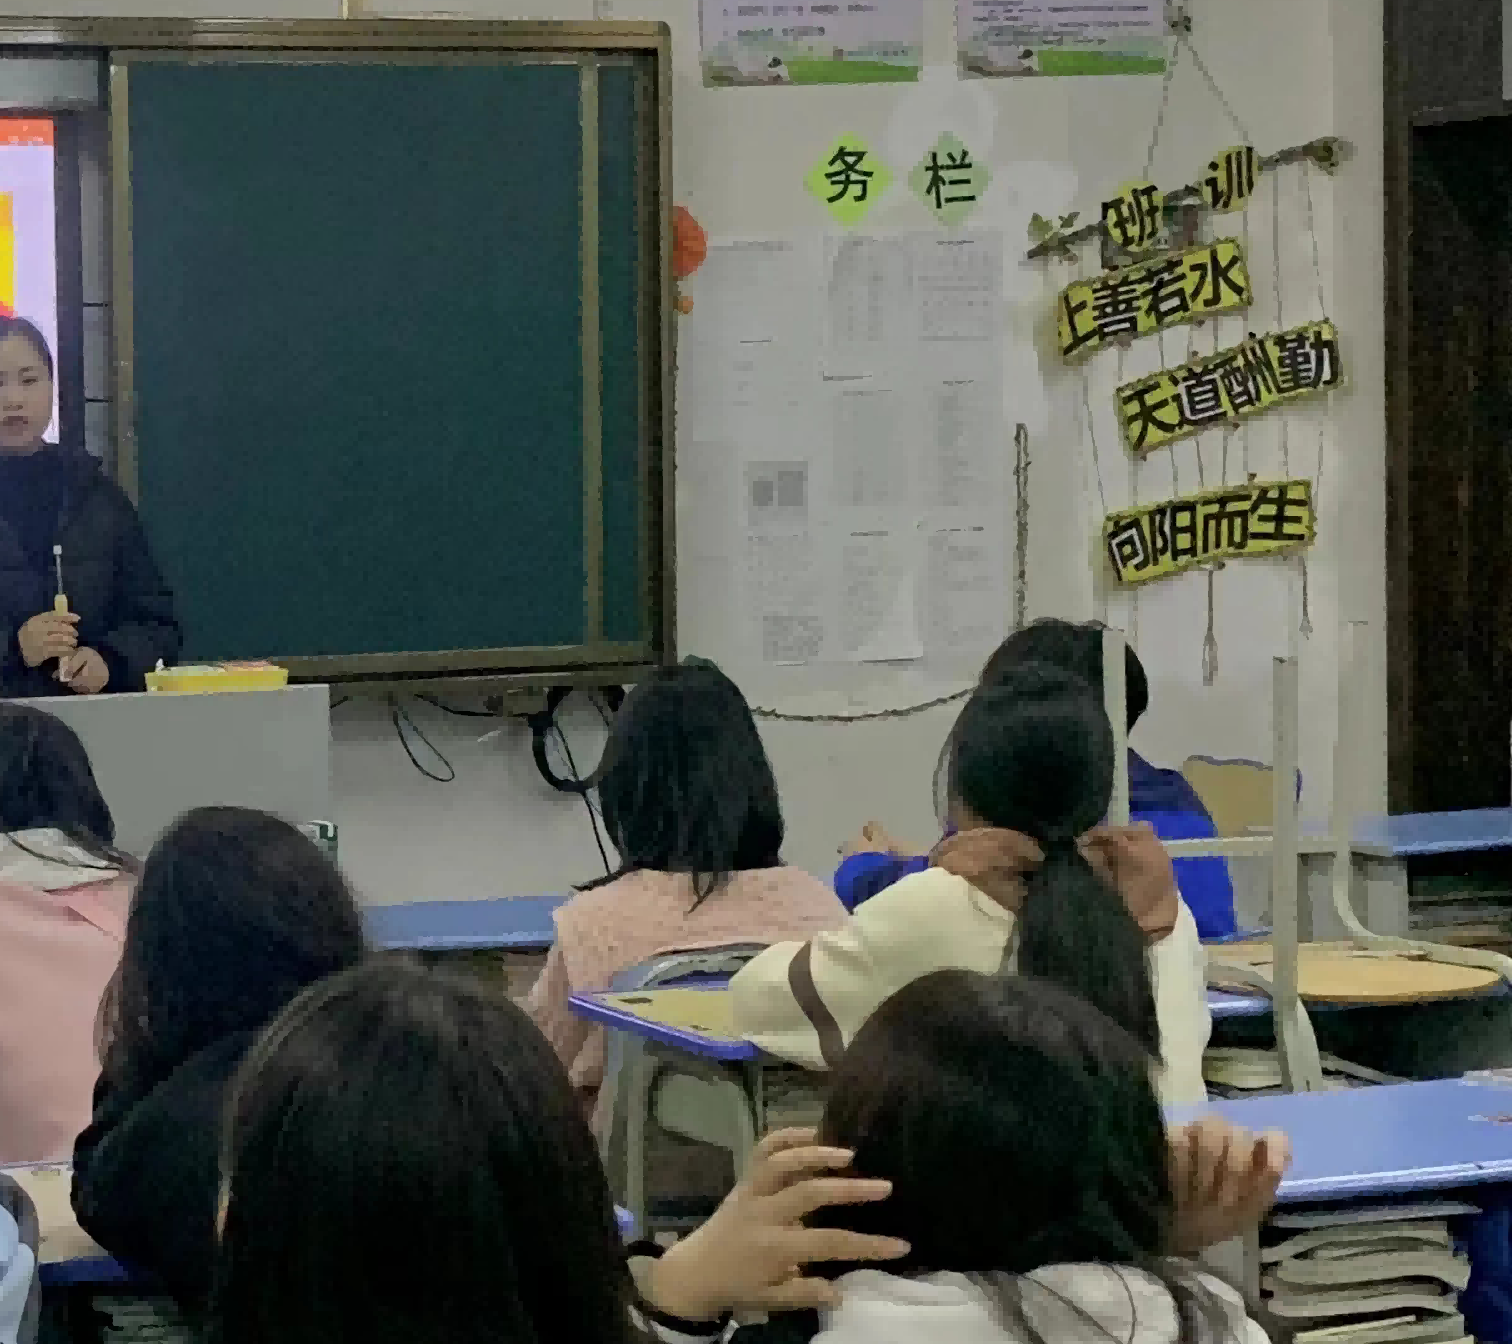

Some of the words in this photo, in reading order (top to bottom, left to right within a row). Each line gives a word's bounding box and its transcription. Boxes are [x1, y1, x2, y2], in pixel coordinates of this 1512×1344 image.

[824, 146, 874, 203] 务
[925, 148, 976, 209] 栏
[1105, 184, 1161, 249] 班
[1204, 145, 1255, 209] 训
[1061, 247, 1245, 357] 上善若水
[1121, 329, 1341, 452] 天道酬勤
[1107, 486, 1309, 582] 向阳而生
